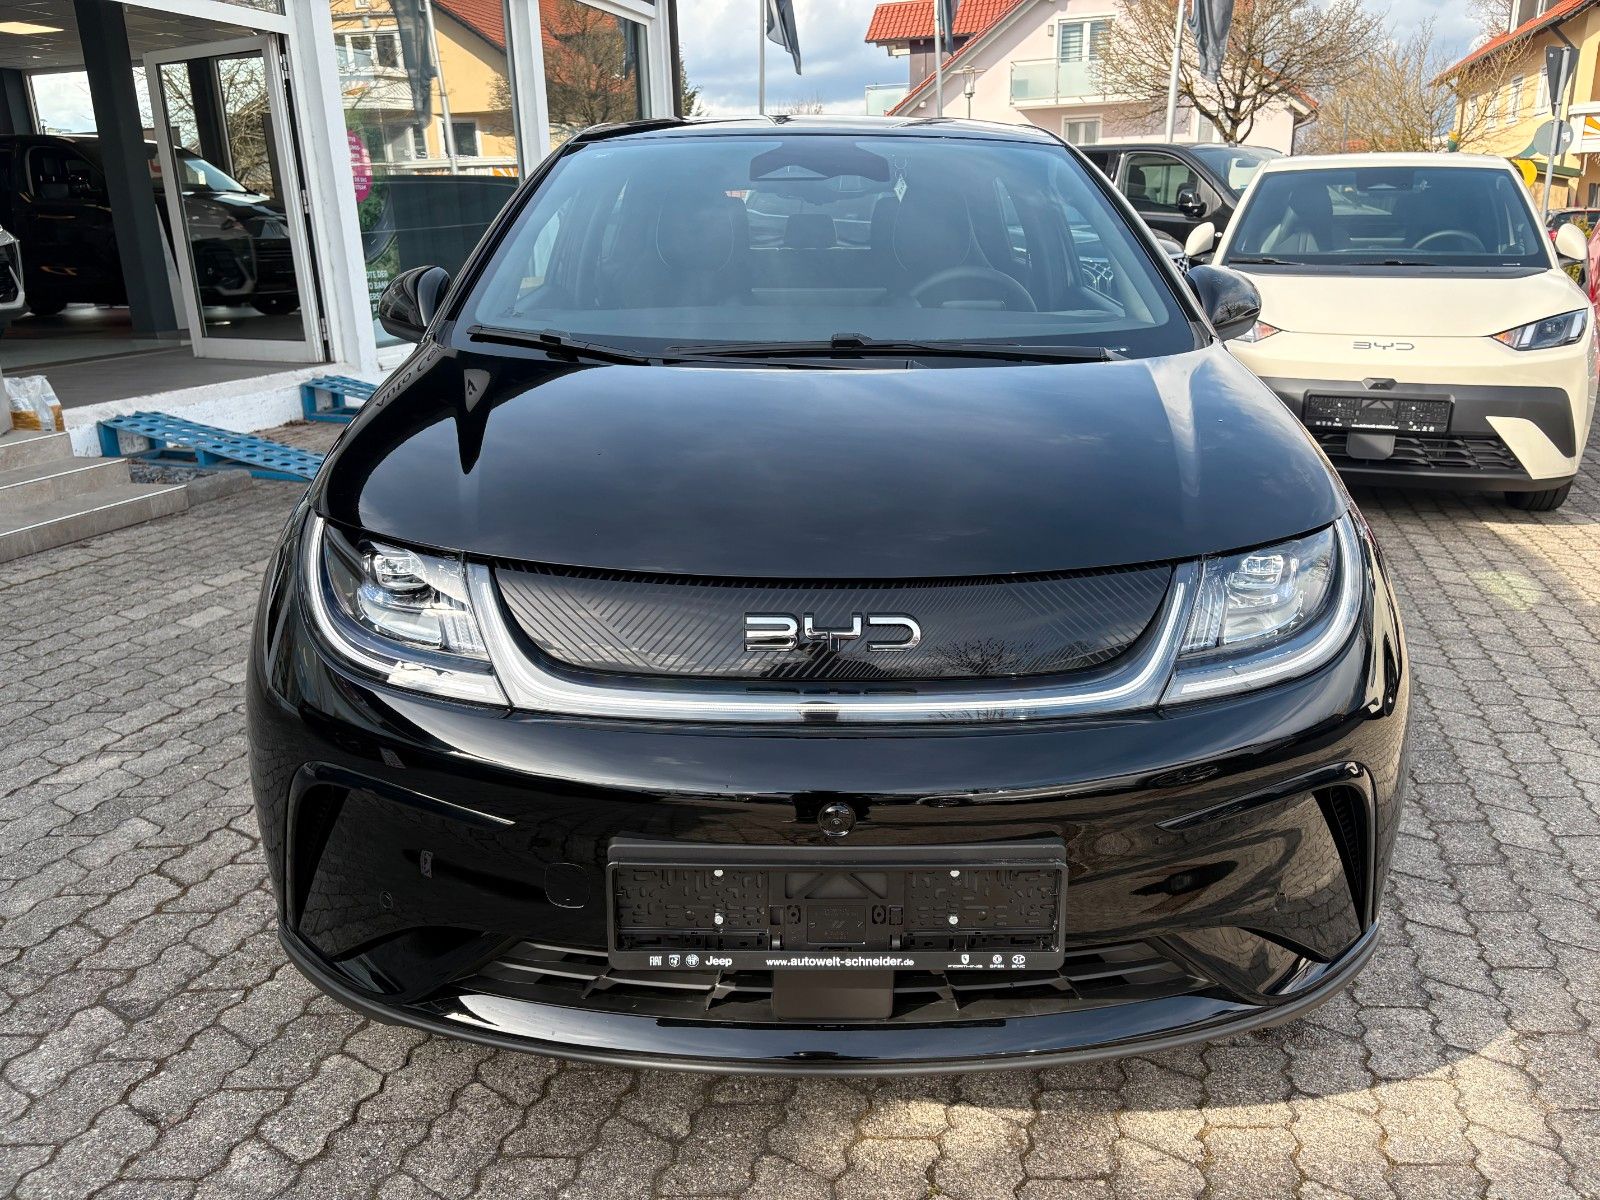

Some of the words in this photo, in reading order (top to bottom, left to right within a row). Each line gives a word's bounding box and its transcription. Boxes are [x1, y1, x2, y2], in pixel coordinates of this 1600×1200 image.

[1353, 341, 1415, 351] BYD
[745, 613, 921, 652] BYD
[705, 956, 732, 967] Jeep
[766, 956, 914, 966] www.autowelt-schneider.de
